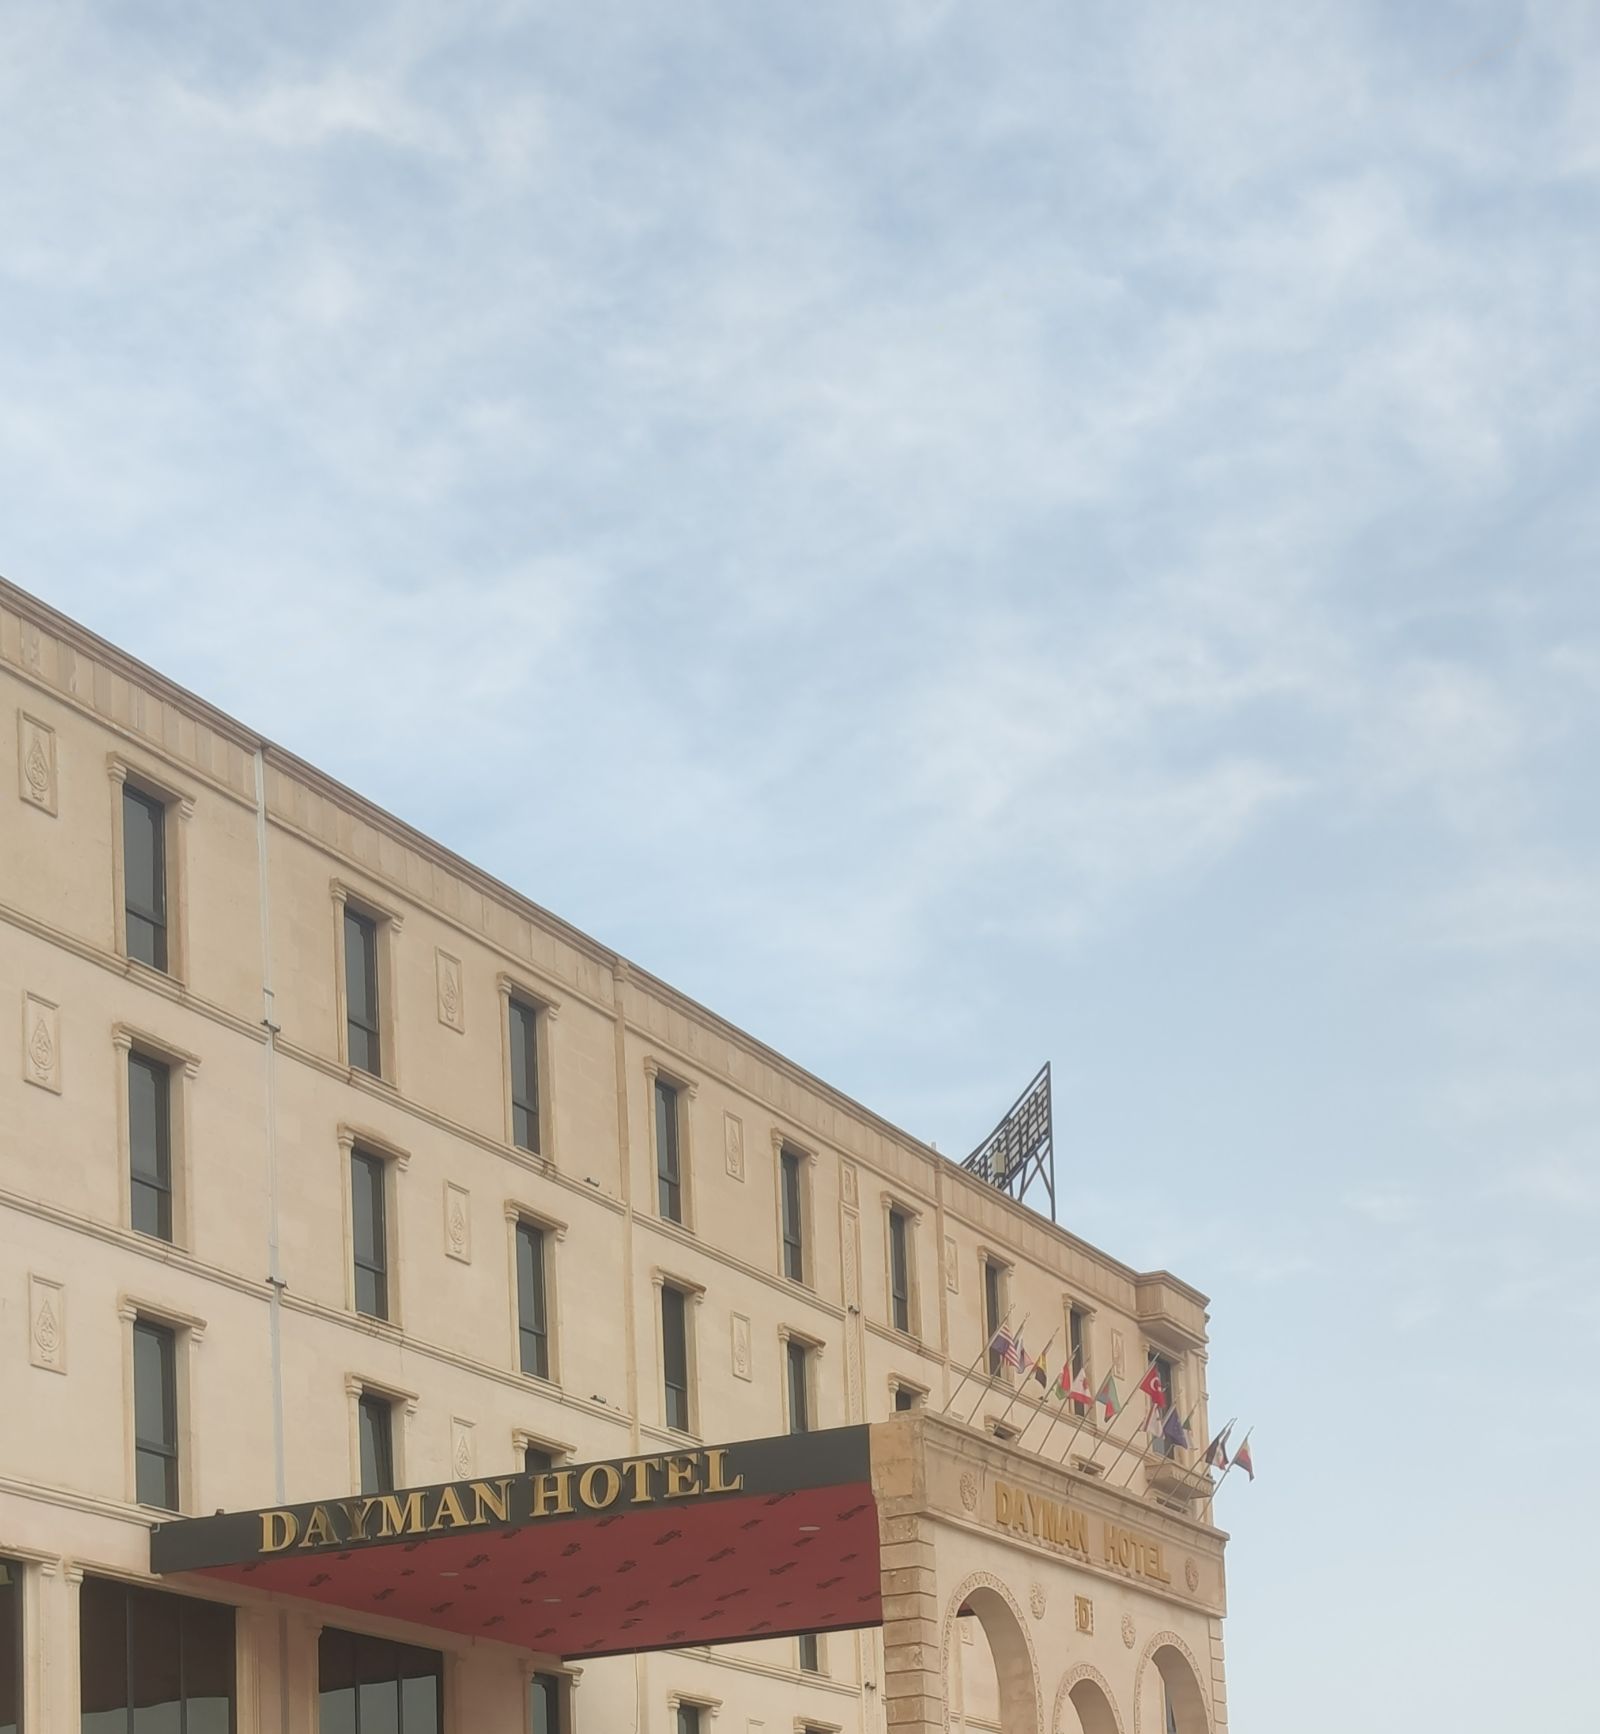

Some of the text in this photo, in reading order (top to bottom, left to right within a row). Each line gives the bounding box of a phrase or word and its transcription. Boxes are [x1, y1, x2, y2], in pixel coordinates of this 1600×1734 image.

[258, 1448, 745, 1553] DAYMAN HOTEL
[995, 1480, 1171, 1585] DAYMAN HOTEL
